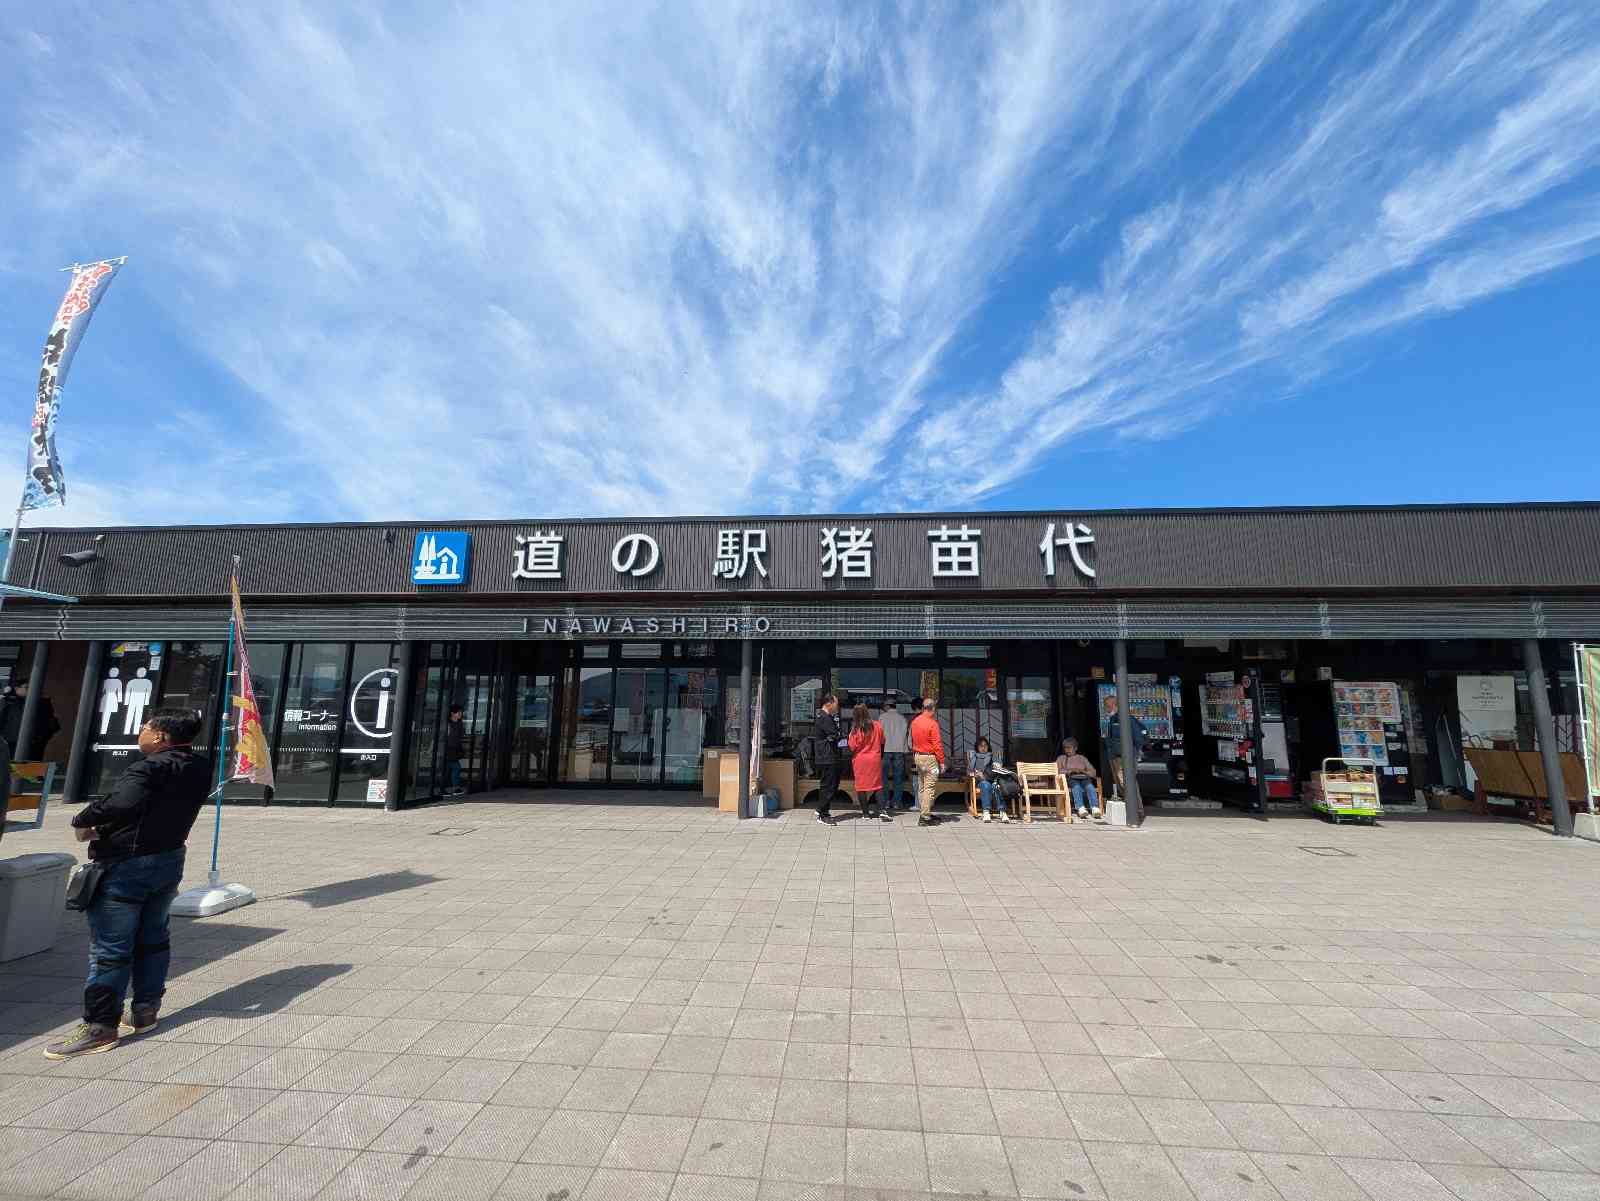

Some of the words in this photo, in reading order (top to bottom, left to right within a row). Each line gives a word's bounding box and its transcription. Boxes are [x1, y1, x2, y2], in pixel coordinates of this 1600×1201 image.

[523, 617, 770, 633] INAWASHIRO
[284, 709, 338, 722] 情報コーナー
